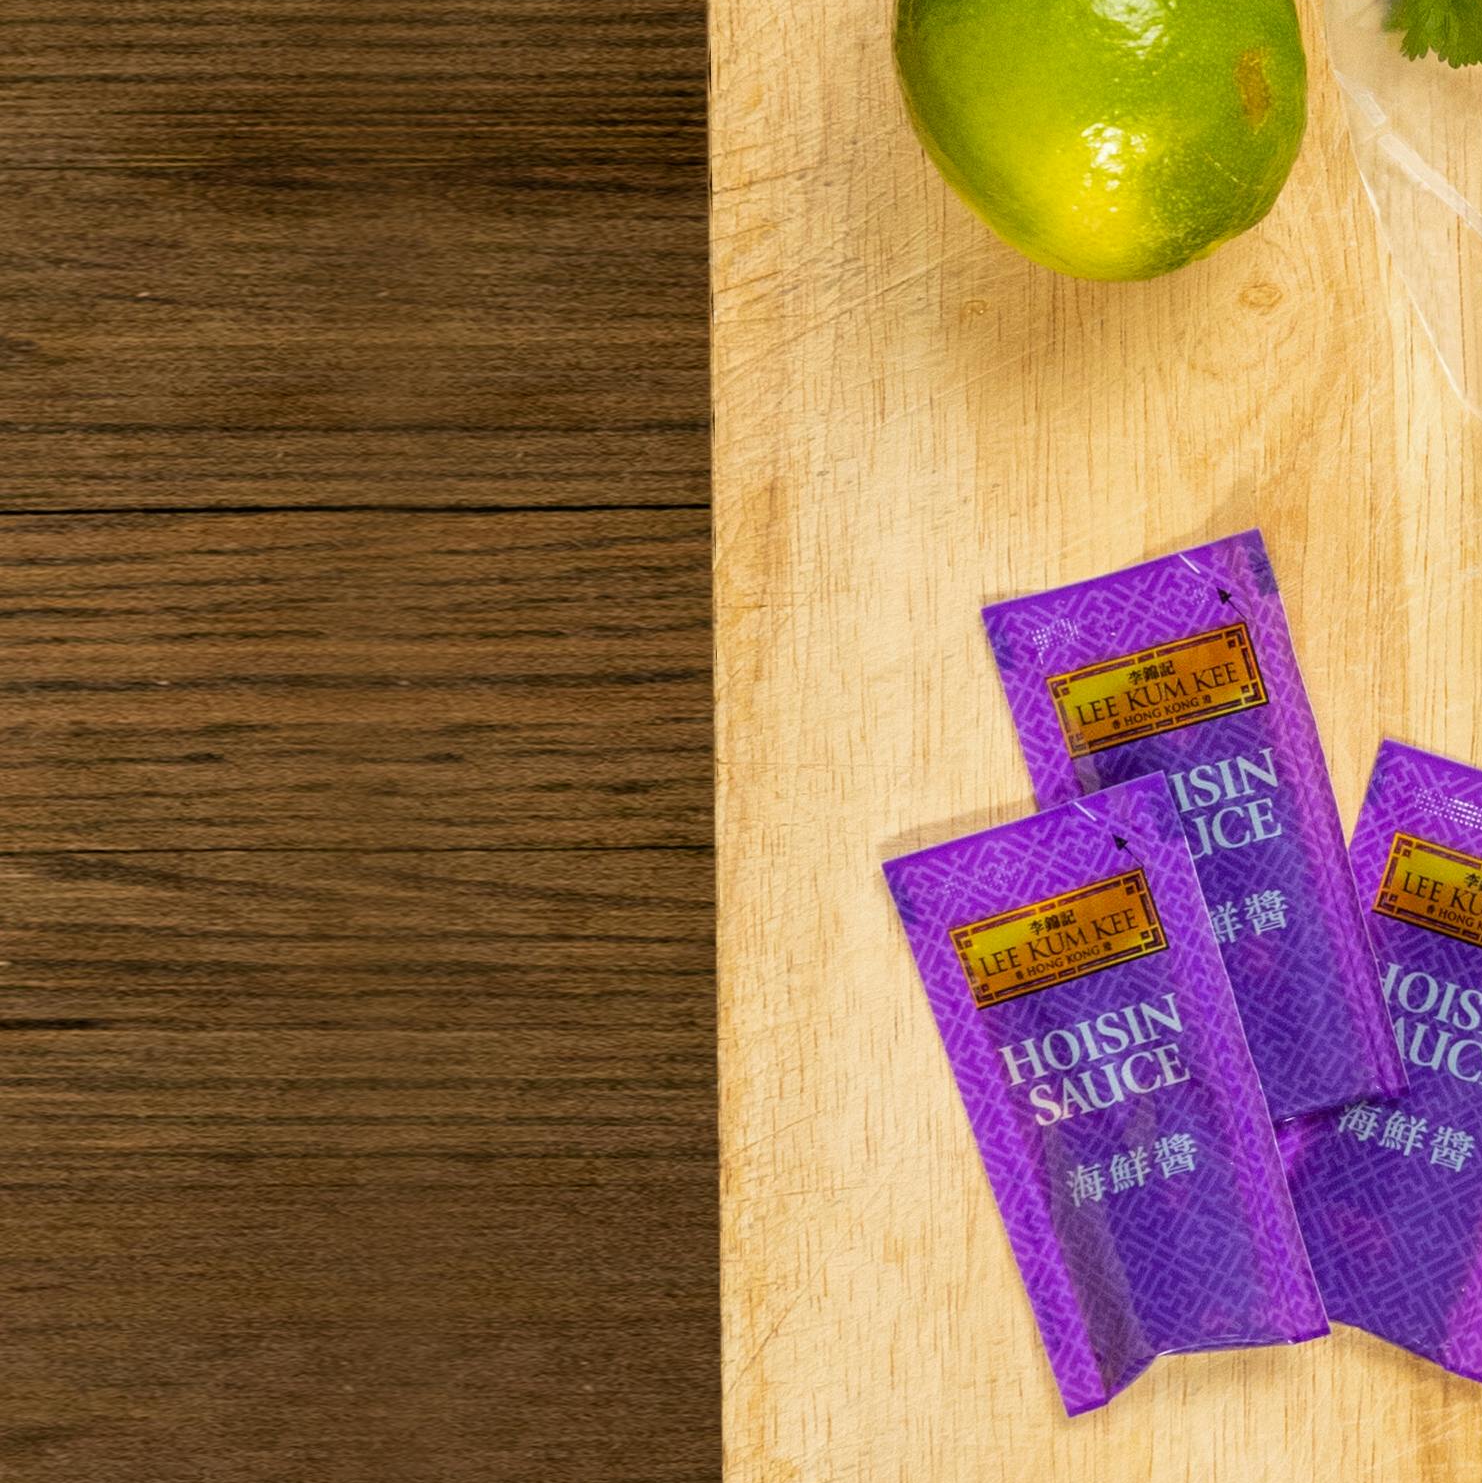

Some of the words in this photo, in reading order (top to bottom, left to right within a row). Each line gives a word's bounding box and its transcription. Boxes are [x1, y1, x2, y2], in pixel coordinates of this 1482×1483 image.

[1075, 695, 1119, 727] LEE
[1128, 676, 1188, 717] KUM
[1192, 661, 1240, 691] KEE
[1127, 660, 1176, 687] 李錦記
[1124, 707, 1162, 728] HONG
[1164, 697, 1200, 718] KONG
[1168, 747, 1280, 813] ISIN
[1402, 870, 1443, 903] LEE
[978, 946, 1020, 978] LEE
[1029, 925, 1090, 961] KUM
[1095, 908, 1140, 942] KEE
[1027, 909, 1077, 937] 李錦記
[1438, 907, 1475, 930] HONG
[1026, 957, 1065, 979] HONG
[1065, 947, 1101, 969] KONG
[997, 992, 1185, 1088] HOISIN
[1028, 1043, 1191, 1127] SAUCE
[1065, 1132, 1198, 1208] 海鮮醬
